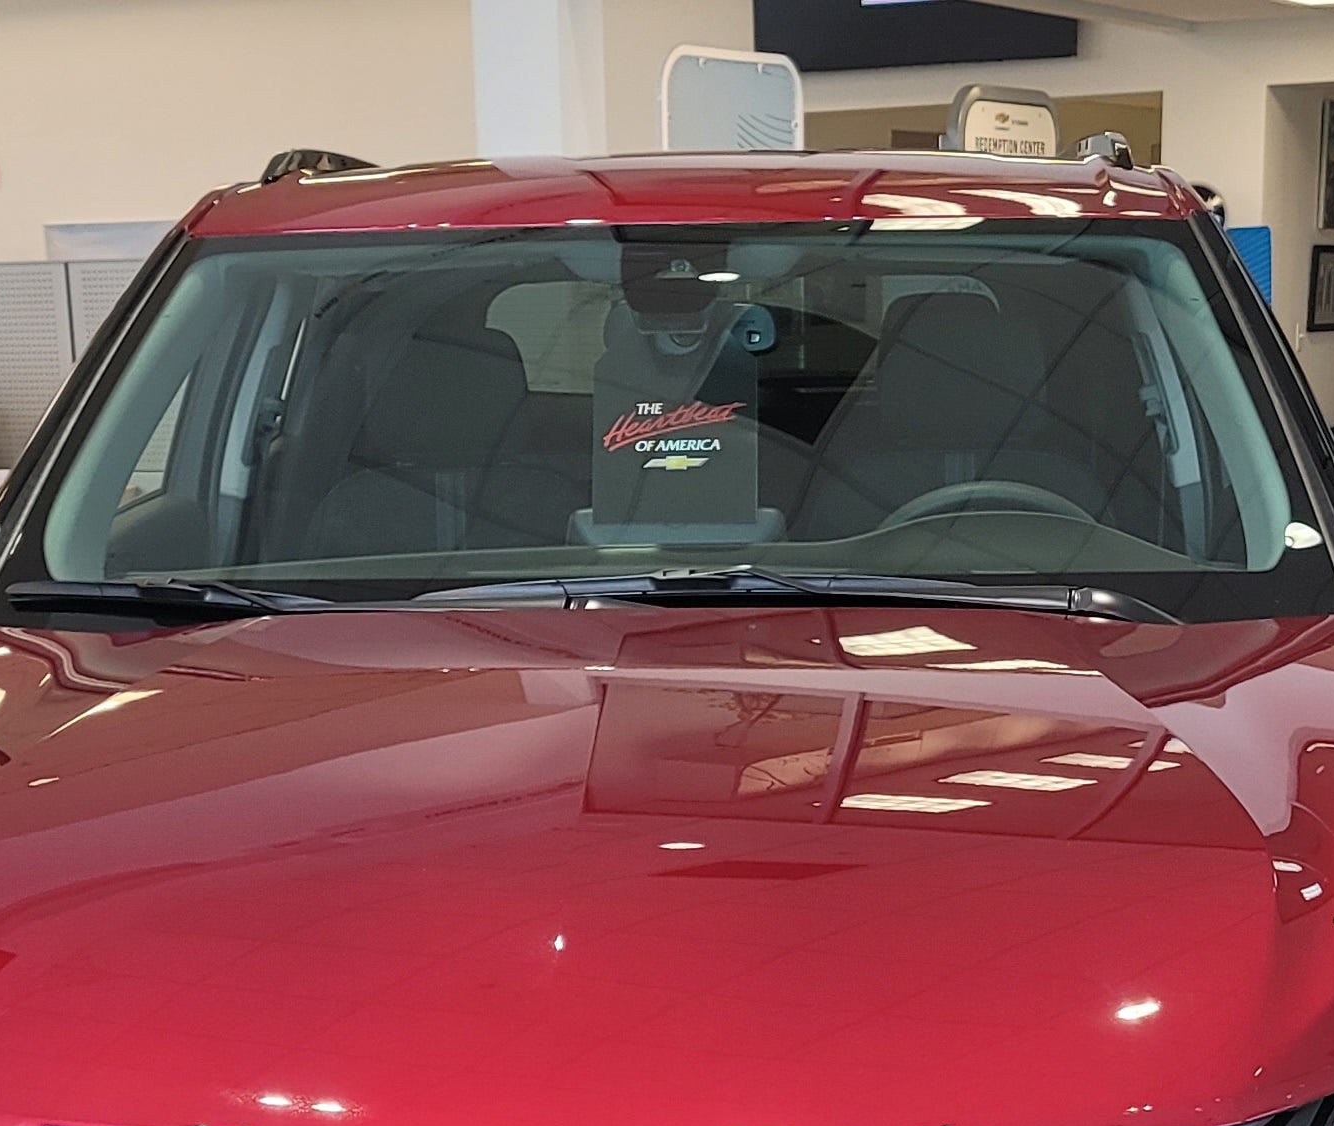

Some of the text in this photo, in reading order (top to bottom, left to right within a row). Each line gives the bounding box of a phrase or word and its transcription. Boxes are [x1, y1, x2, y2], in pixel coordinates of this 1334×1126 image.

[975, 137, 1046, 155] REDEMPTION CENTER
[636, 403, 664, 415] THE
[603, 401, 747, 452] Heartbeat
[634, 439, 721, 452] OF AMERICA
